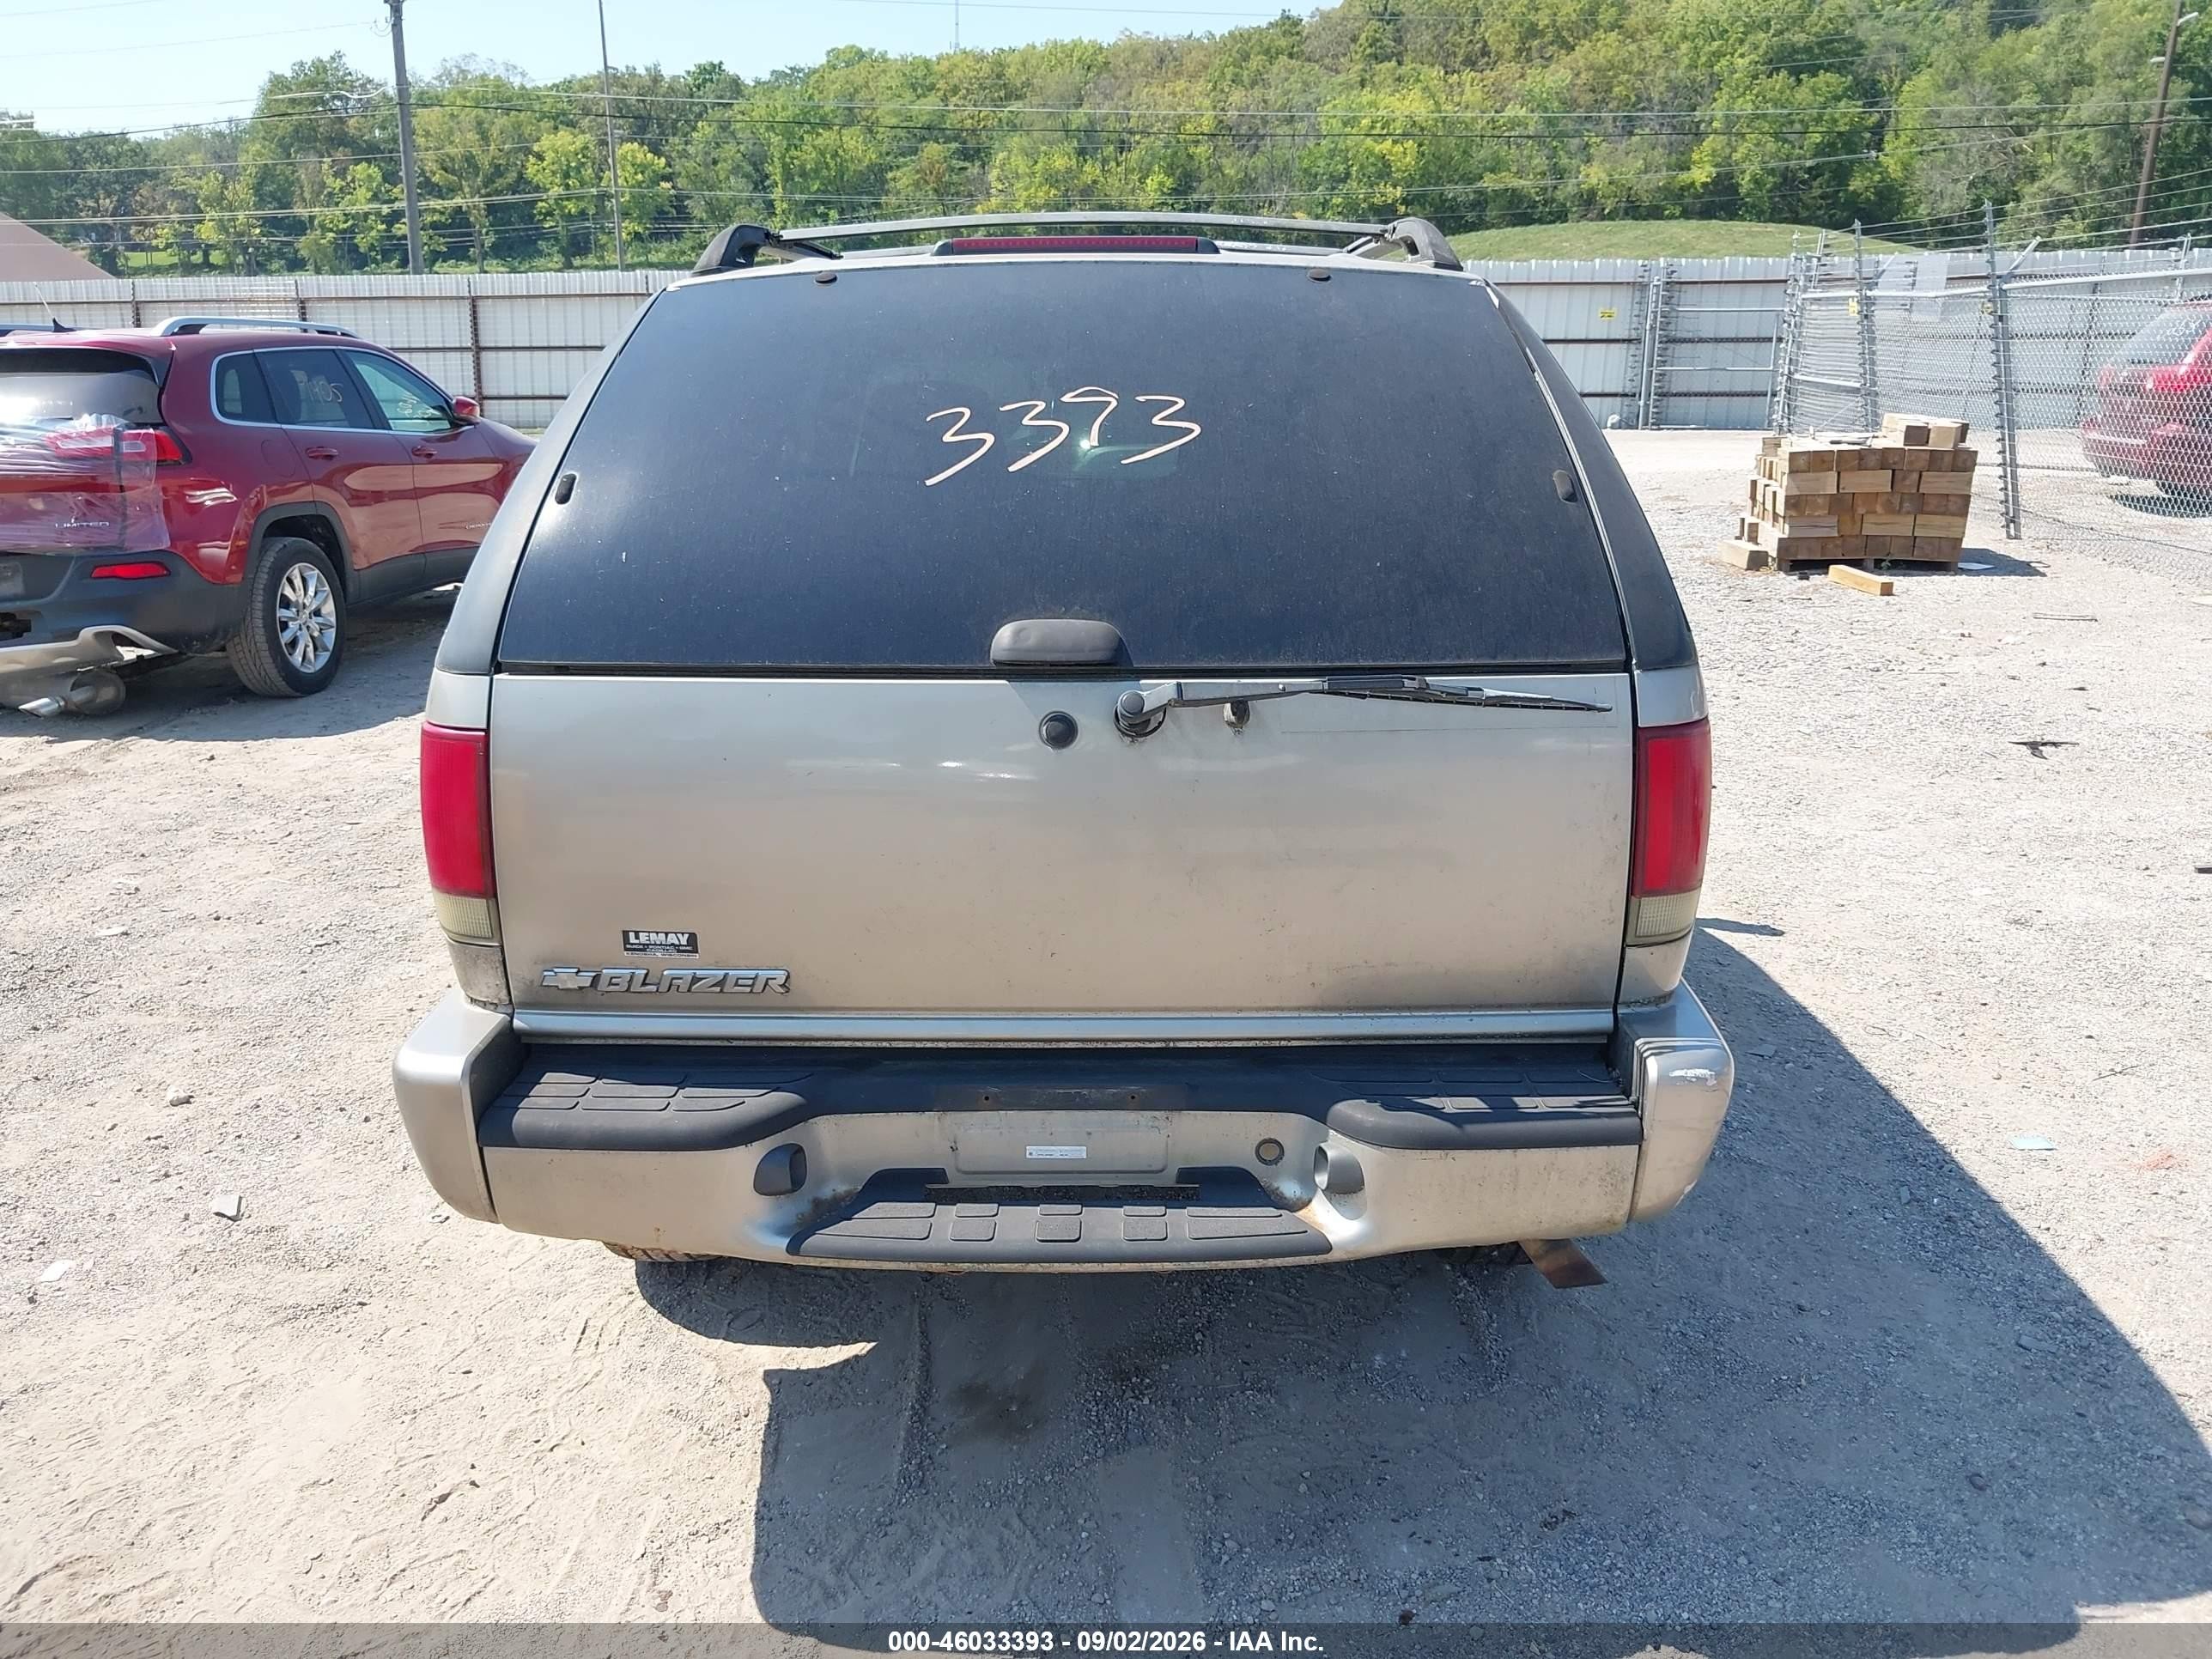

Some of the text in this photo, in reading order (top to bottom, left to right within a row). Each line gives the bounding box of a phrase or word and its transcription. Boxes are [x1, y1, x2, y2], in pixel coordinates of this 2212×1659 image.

[924, 386, 1202, 487] 3393
[629, 932, 690, 945] LEMAY
[598, 968, 790, 994] BLAZER
